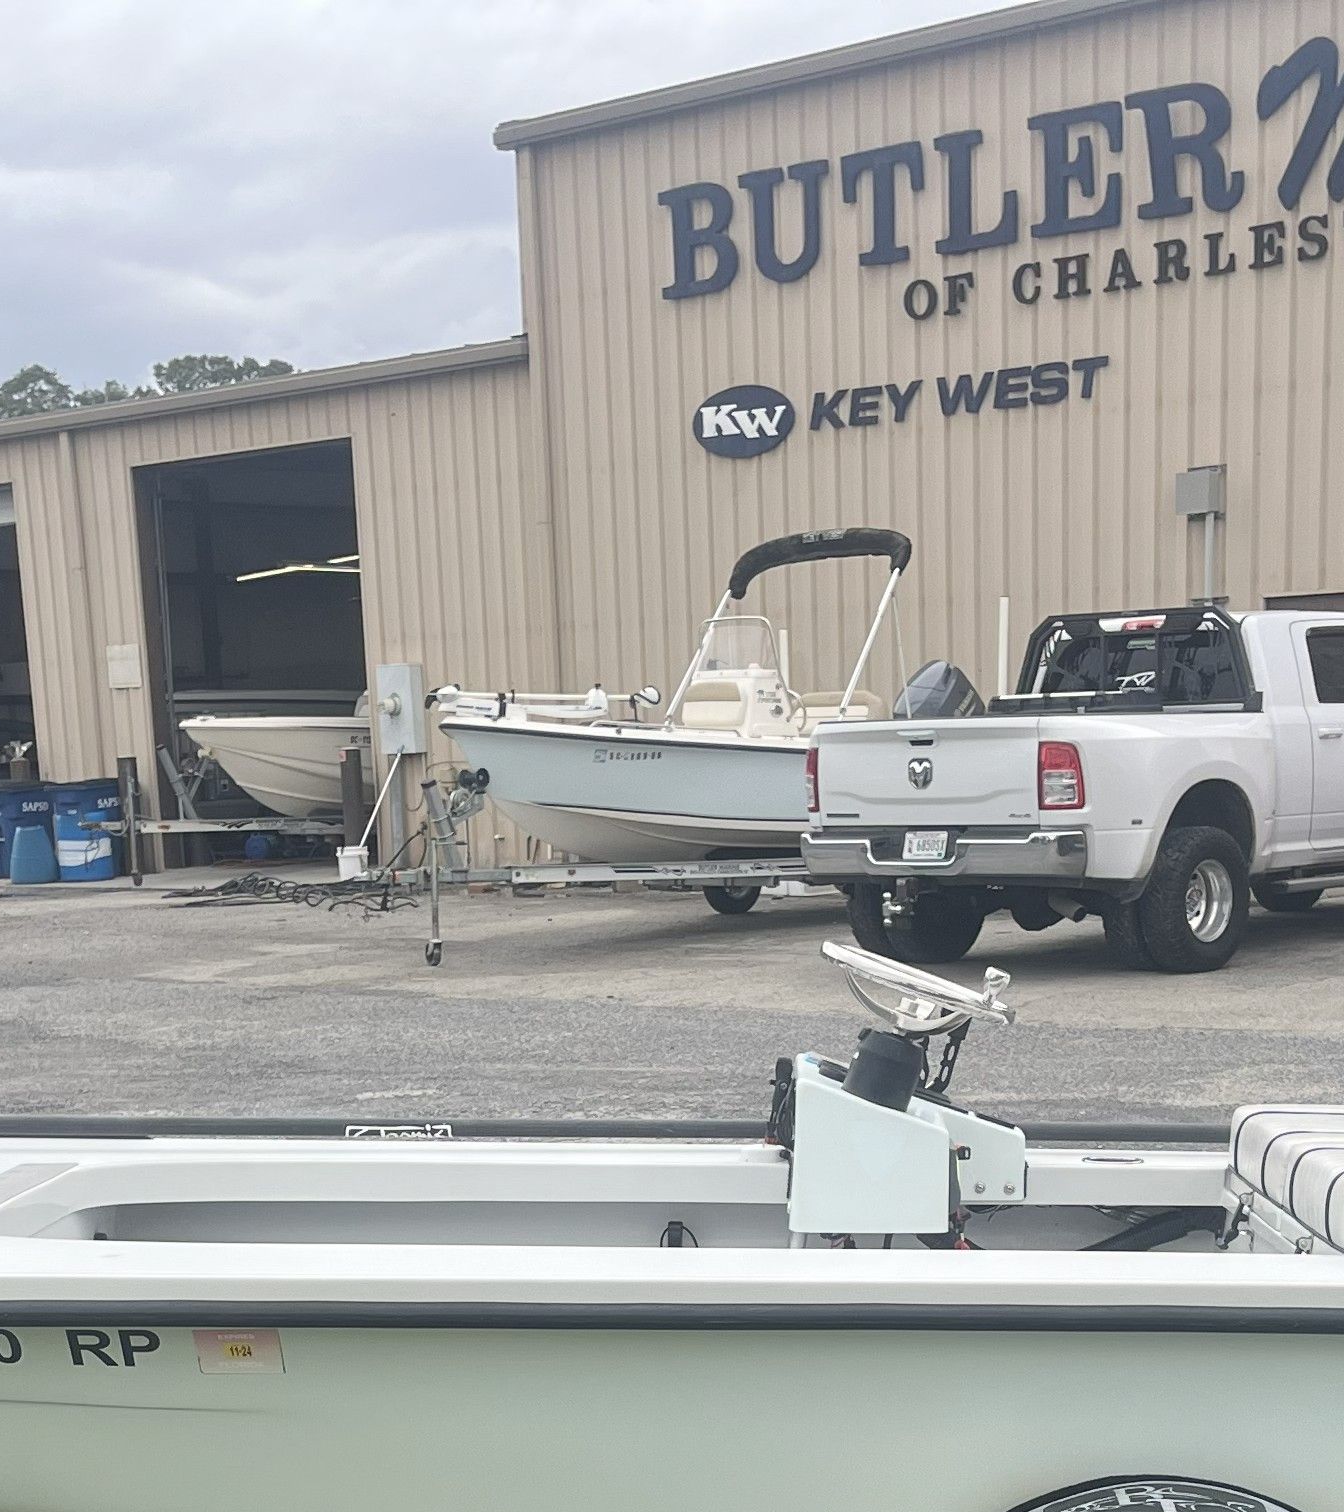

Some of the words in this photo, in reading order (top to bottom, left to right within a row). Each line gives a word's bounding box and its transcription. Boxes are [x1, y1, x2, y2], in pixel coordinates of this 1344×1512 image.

[658, 82, 1244, 300] BUTLER
[904, 272, 975, 321] OF
[809, 379, 923, 432] KEY
[936, 355, 1109, 417] WEST
[701, 402, 786, 440] KW
[65, 1328, 161, 1367] RP
